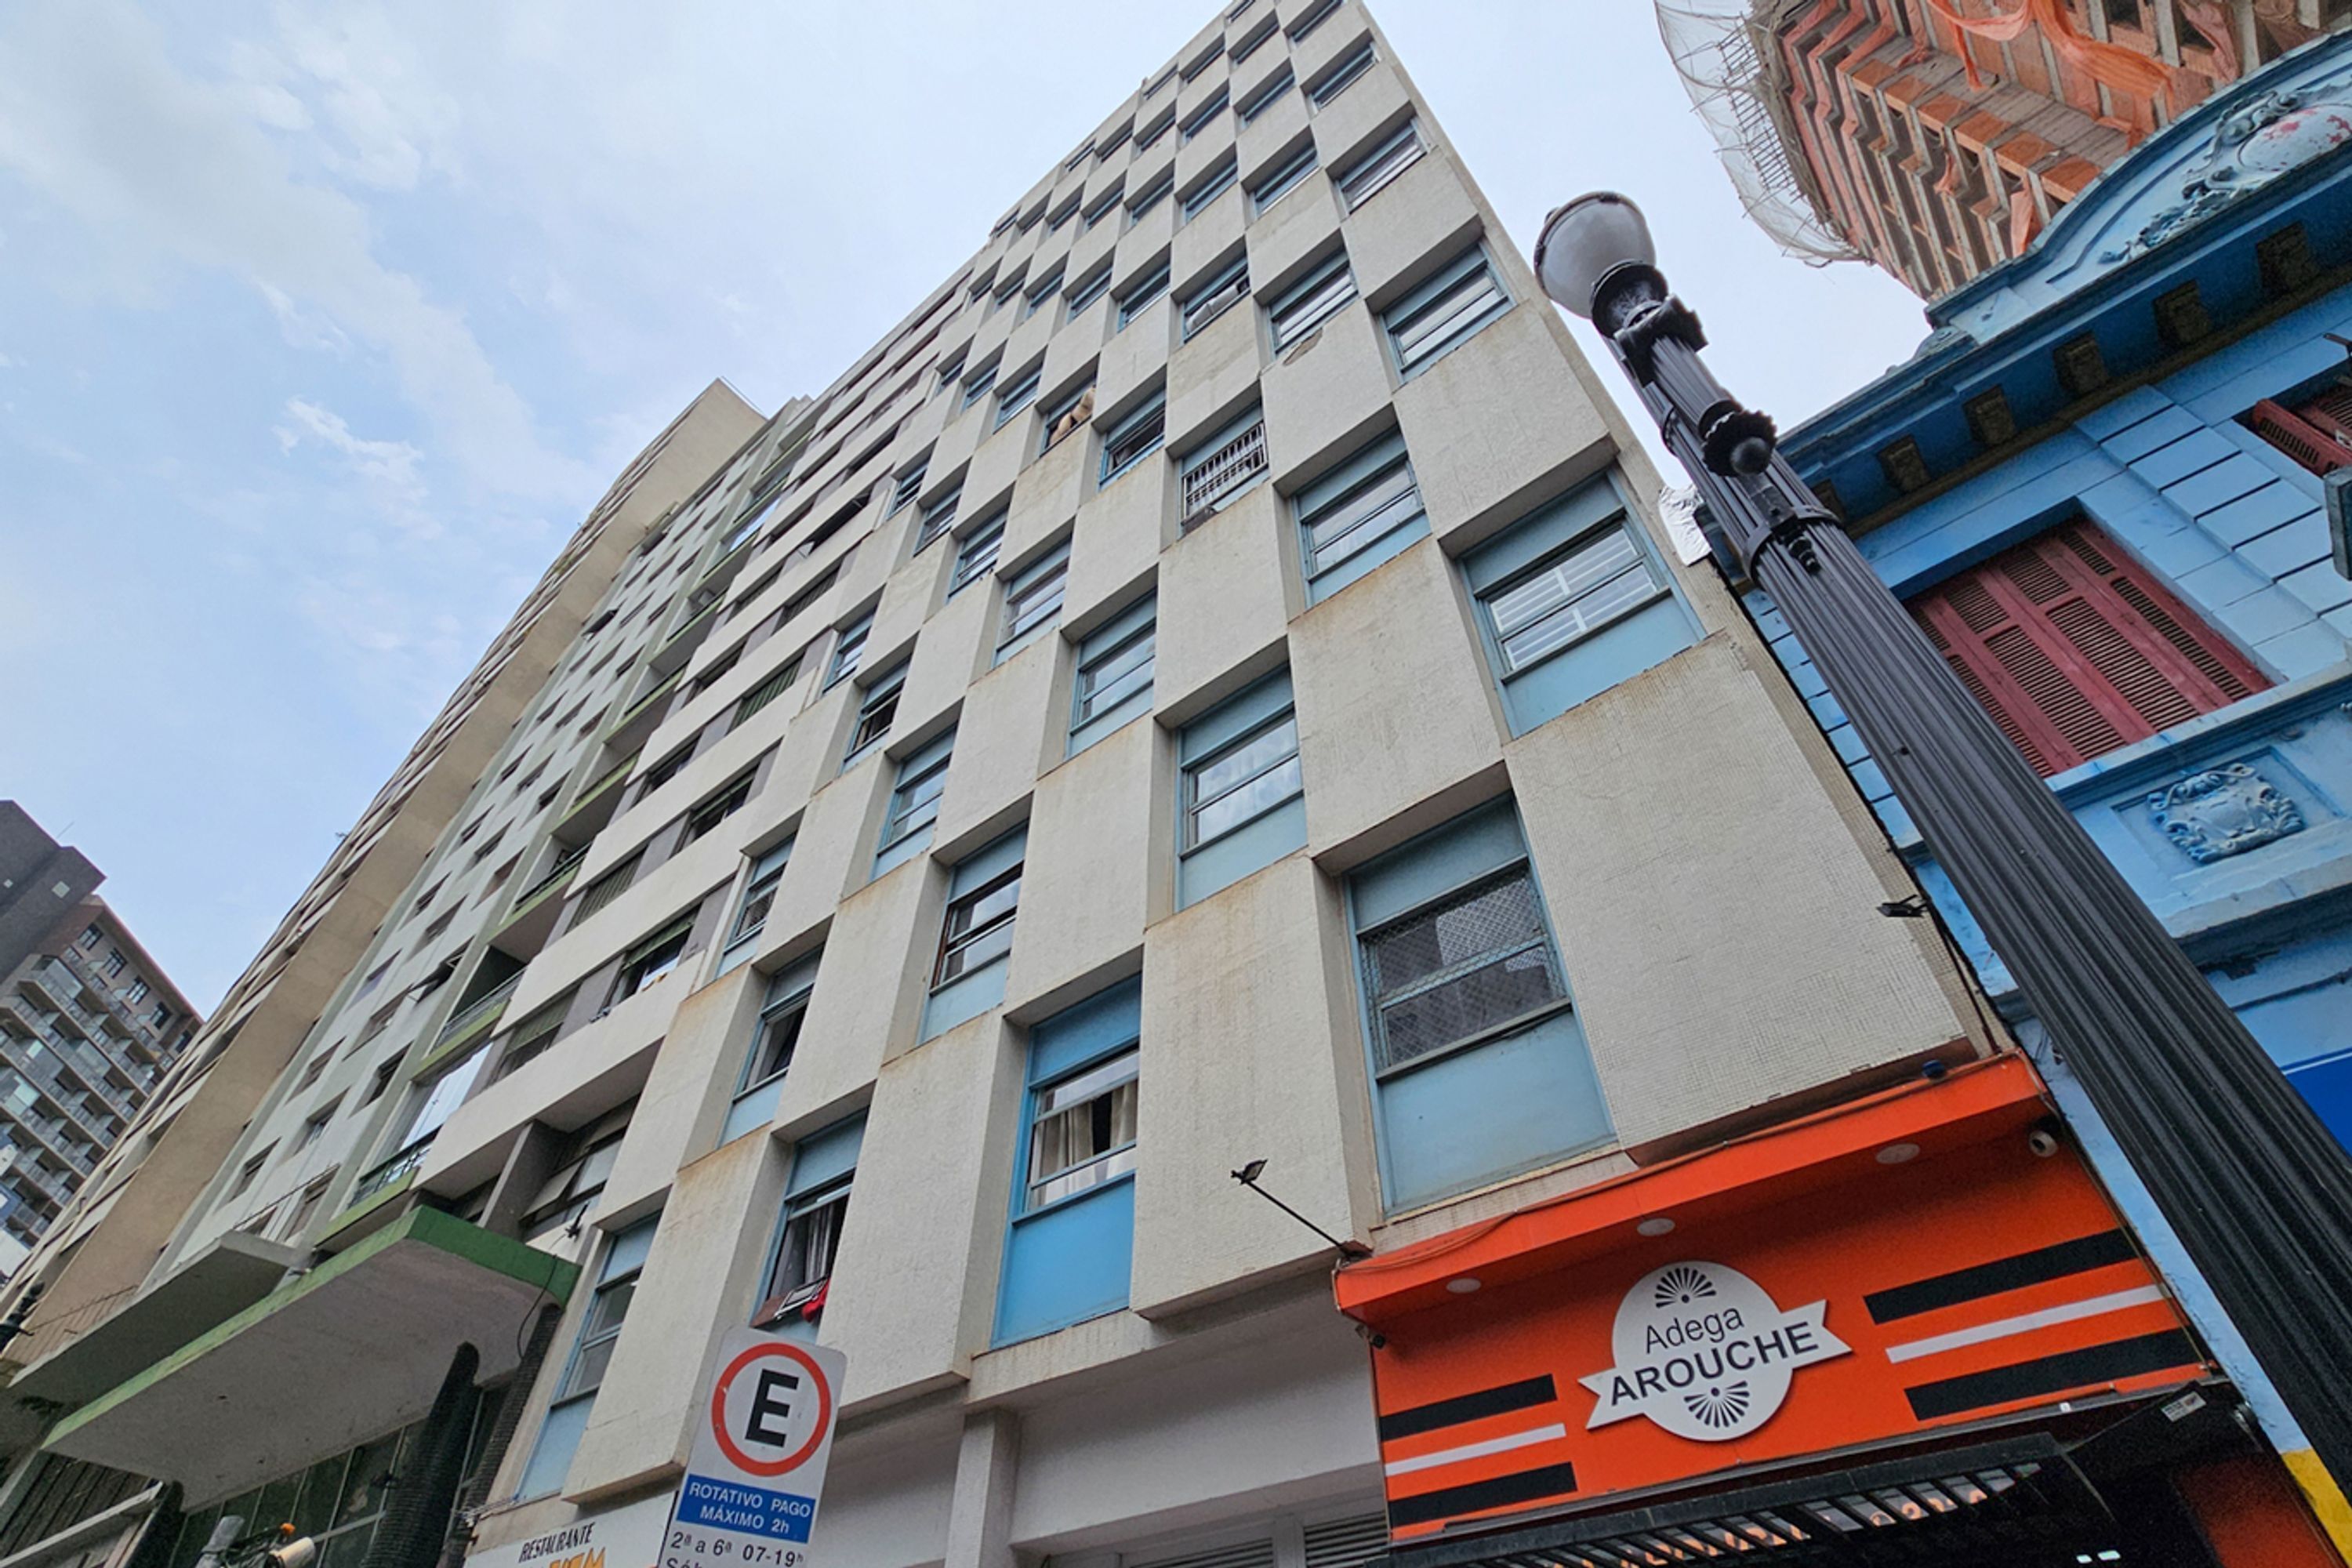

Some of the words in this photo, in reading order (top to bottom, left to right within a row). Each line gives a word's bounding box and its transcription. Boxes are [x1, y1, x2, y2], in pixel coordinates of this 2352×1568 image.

[1646, 1307, 1744, 1355] Adega
[1611, 1321, 1819, 1406] AROUCHE
[745, 1368, 800, 1448] E
[688, 1482, 763, 1509] ROTATIVO
[770, 1498, 811, 1518] PAGO
[699, 1503, 764, 1530] MÁXIMO
[771, 1519, 790, 1534] 2h
[518, 1522, 596, 1563] RESTAURANTE
[695, 1540, 706, 1553] a
